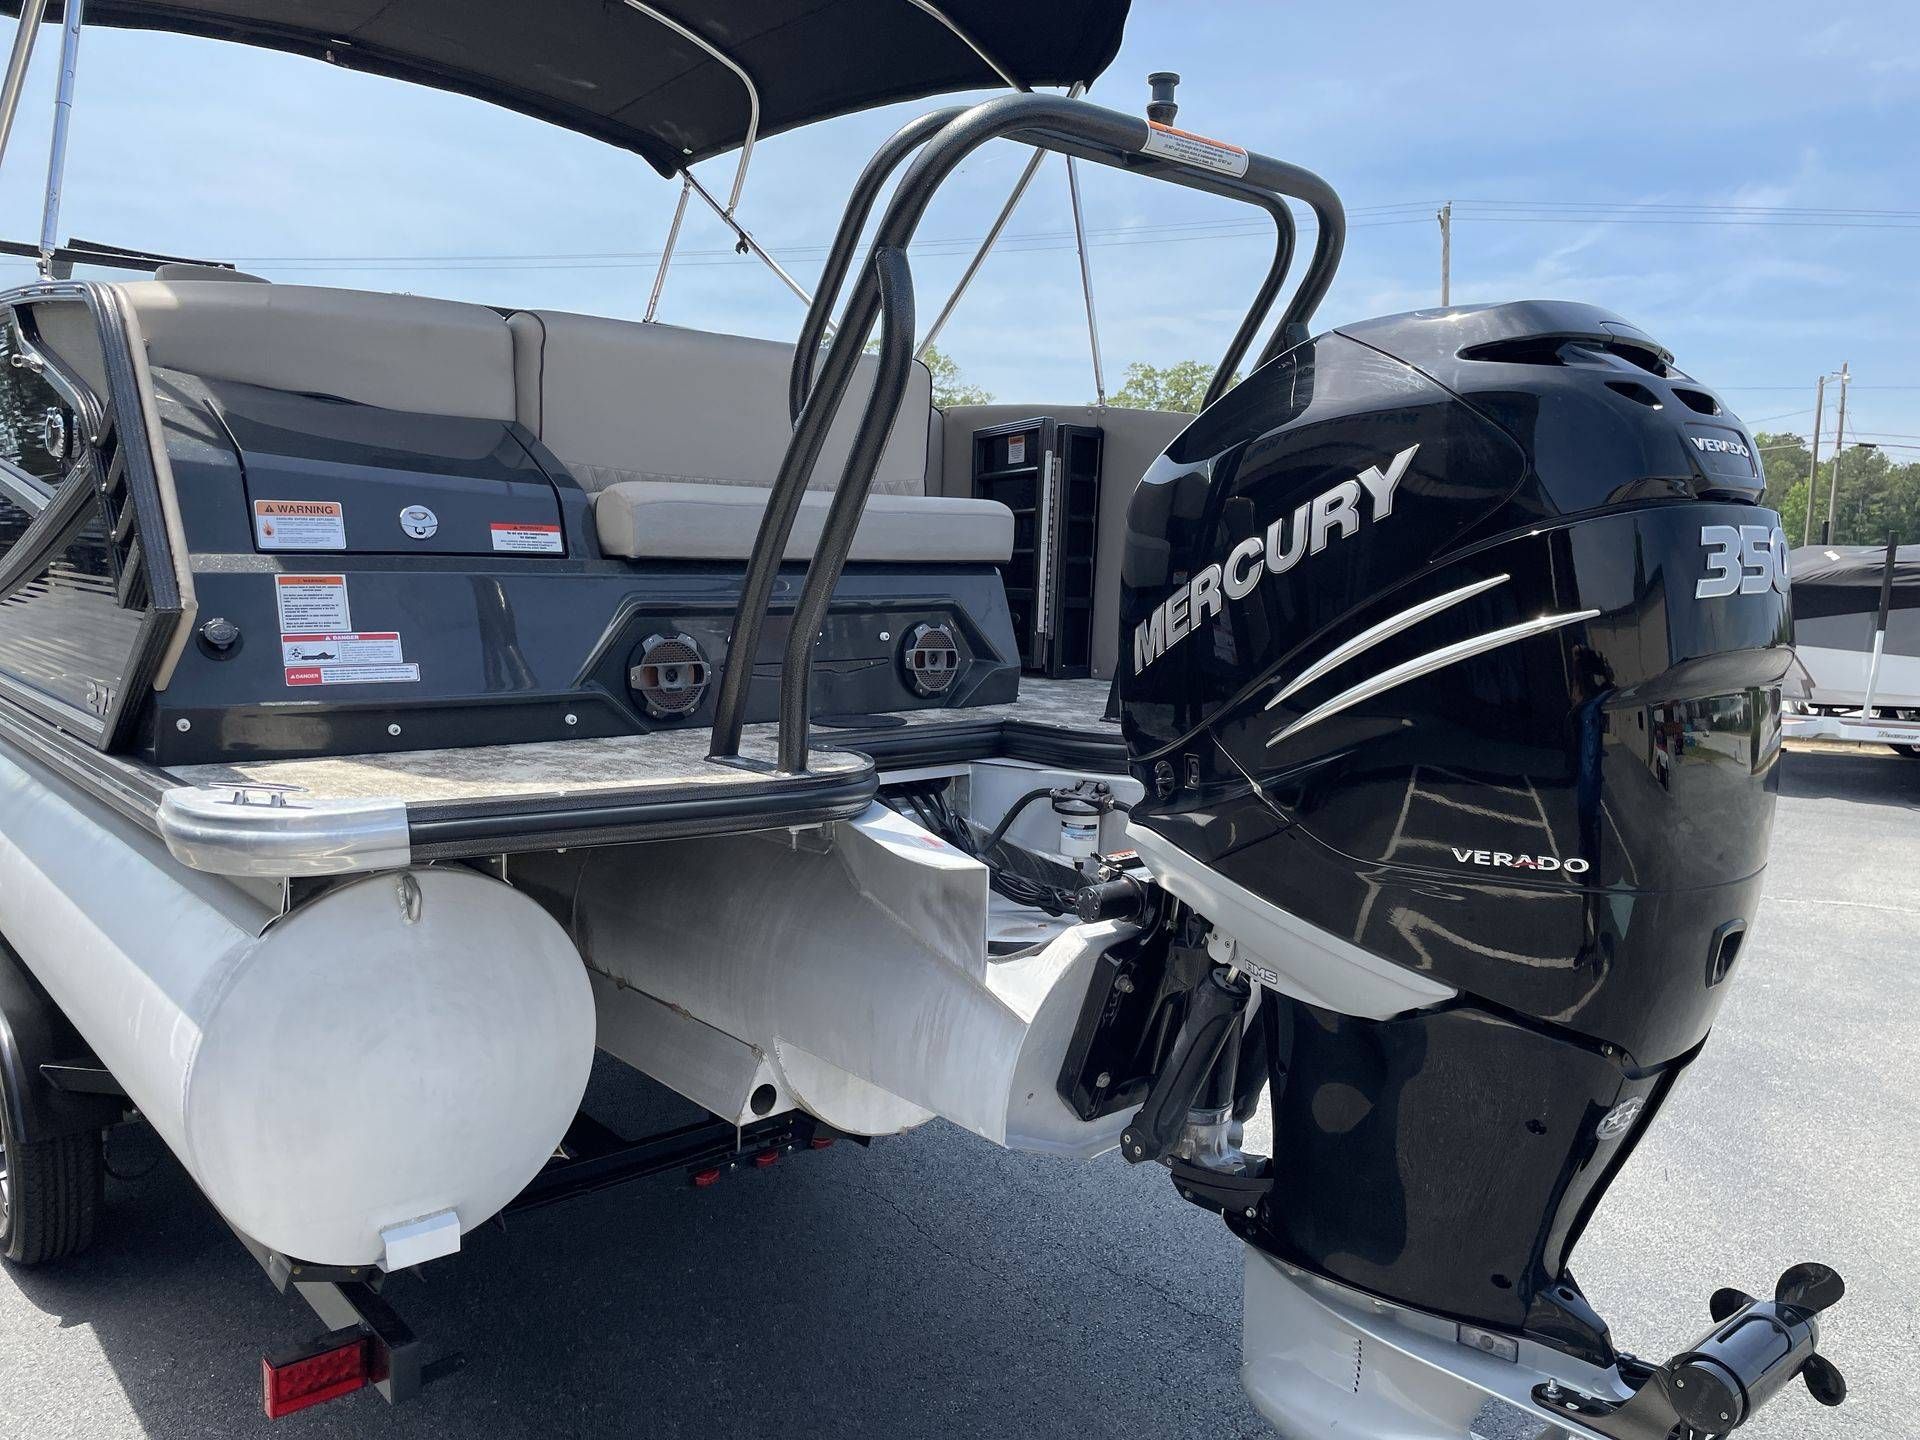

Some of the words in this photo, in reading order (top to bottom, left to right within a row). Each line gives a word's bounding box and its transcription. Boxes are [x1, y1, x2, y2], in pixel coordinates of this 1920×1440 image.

[1691, 437, 1749, 458] VERADO
[277, 504, 333, 515] WARNING
[1134, 443, 1421, 676] MERCURY
[1695, 525, 1792, 600] 350
[1451, 847, 1590, 874] VERADO
